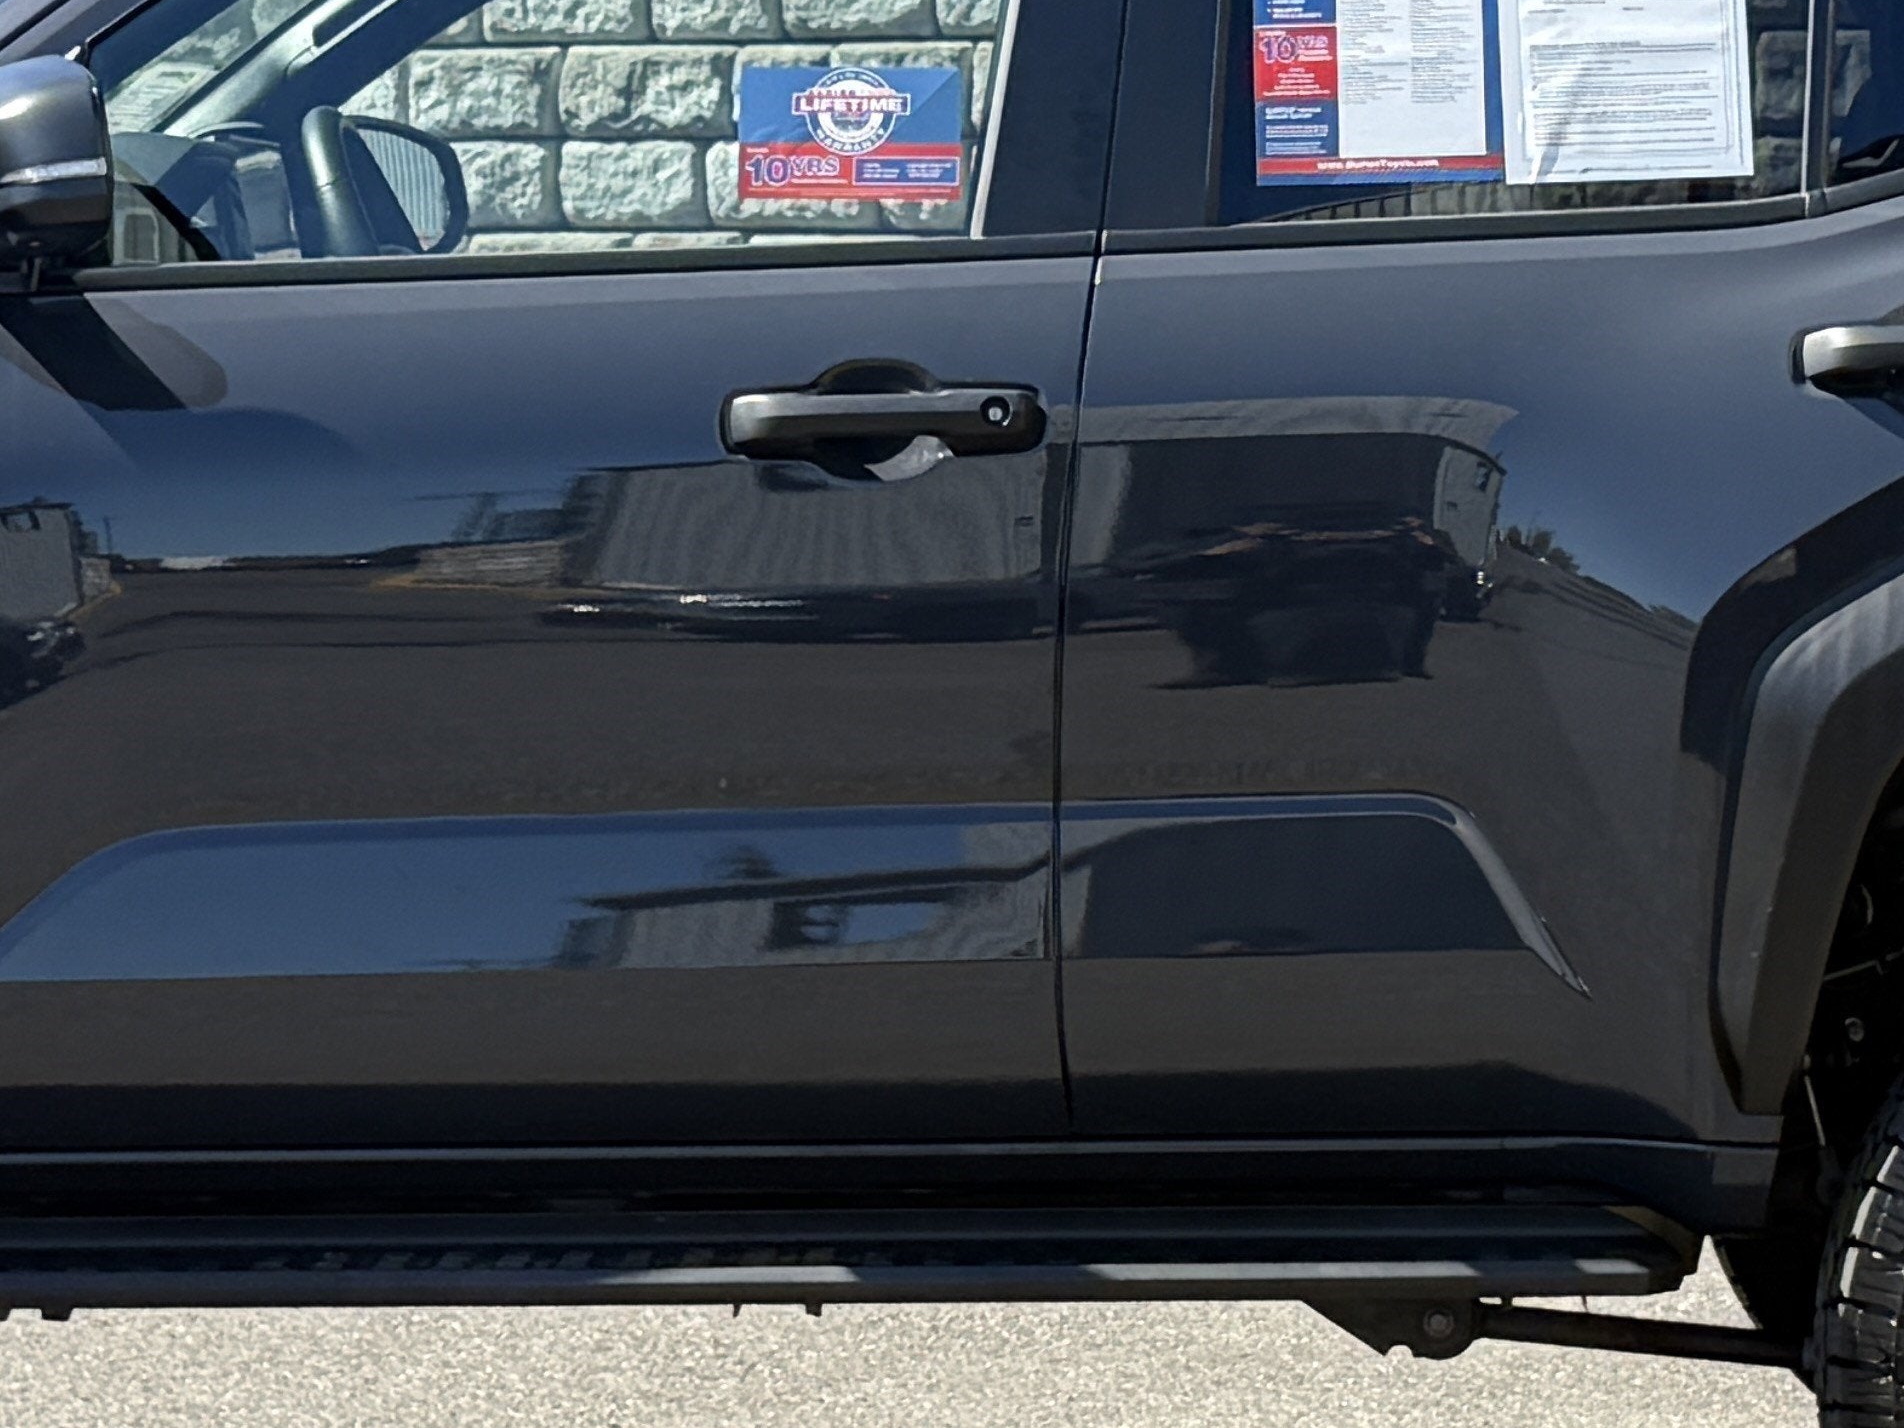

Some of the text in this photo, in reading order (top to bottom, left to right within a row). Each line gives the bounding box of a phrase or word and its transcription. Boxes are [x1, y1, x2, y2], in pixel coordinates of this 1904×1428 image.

[1260, 35, 1297, 64] 10
[799, 97, 904, 113] LIFETIME
[745, 155, 792, 186] 10
[791, 156, 840, 176] YRS
